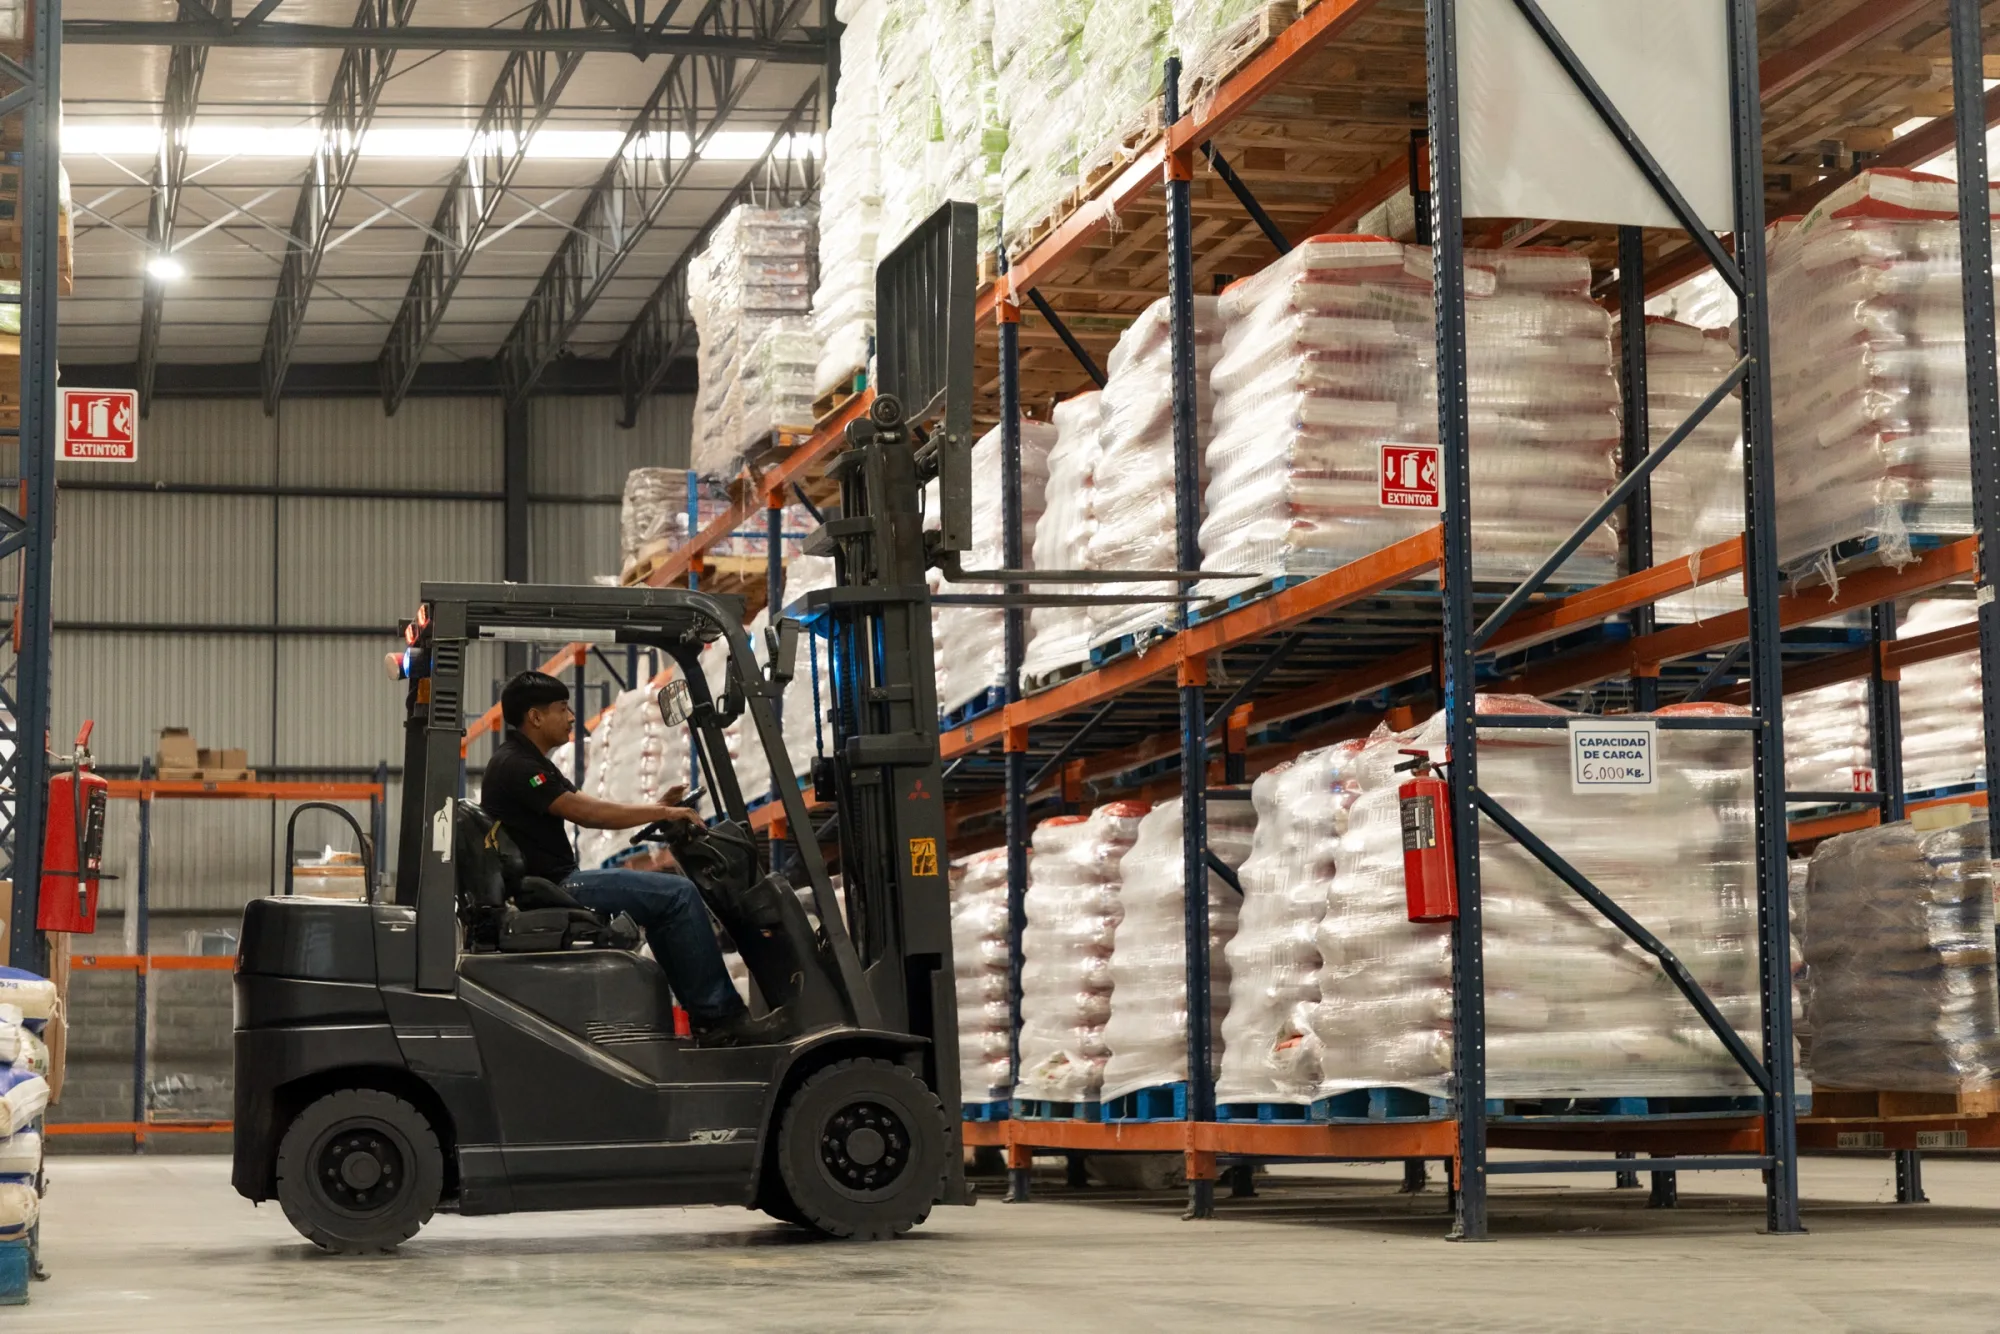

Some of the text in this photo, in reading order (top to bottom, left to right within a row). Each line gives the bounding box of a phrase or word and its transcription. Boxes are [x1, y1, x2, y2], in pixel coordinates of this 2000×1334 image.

[71, 443, 127, 456] EXTINTOR
[1387, 492, 1433, 506] EXTINTOR
[1579, 738, 1646, 747] CAPACIDAD
[1584, 751, 1643, 759] DE CARGA
[1626, 768, 1644, 778] Kg.
[437, 810, 449, 823] A
